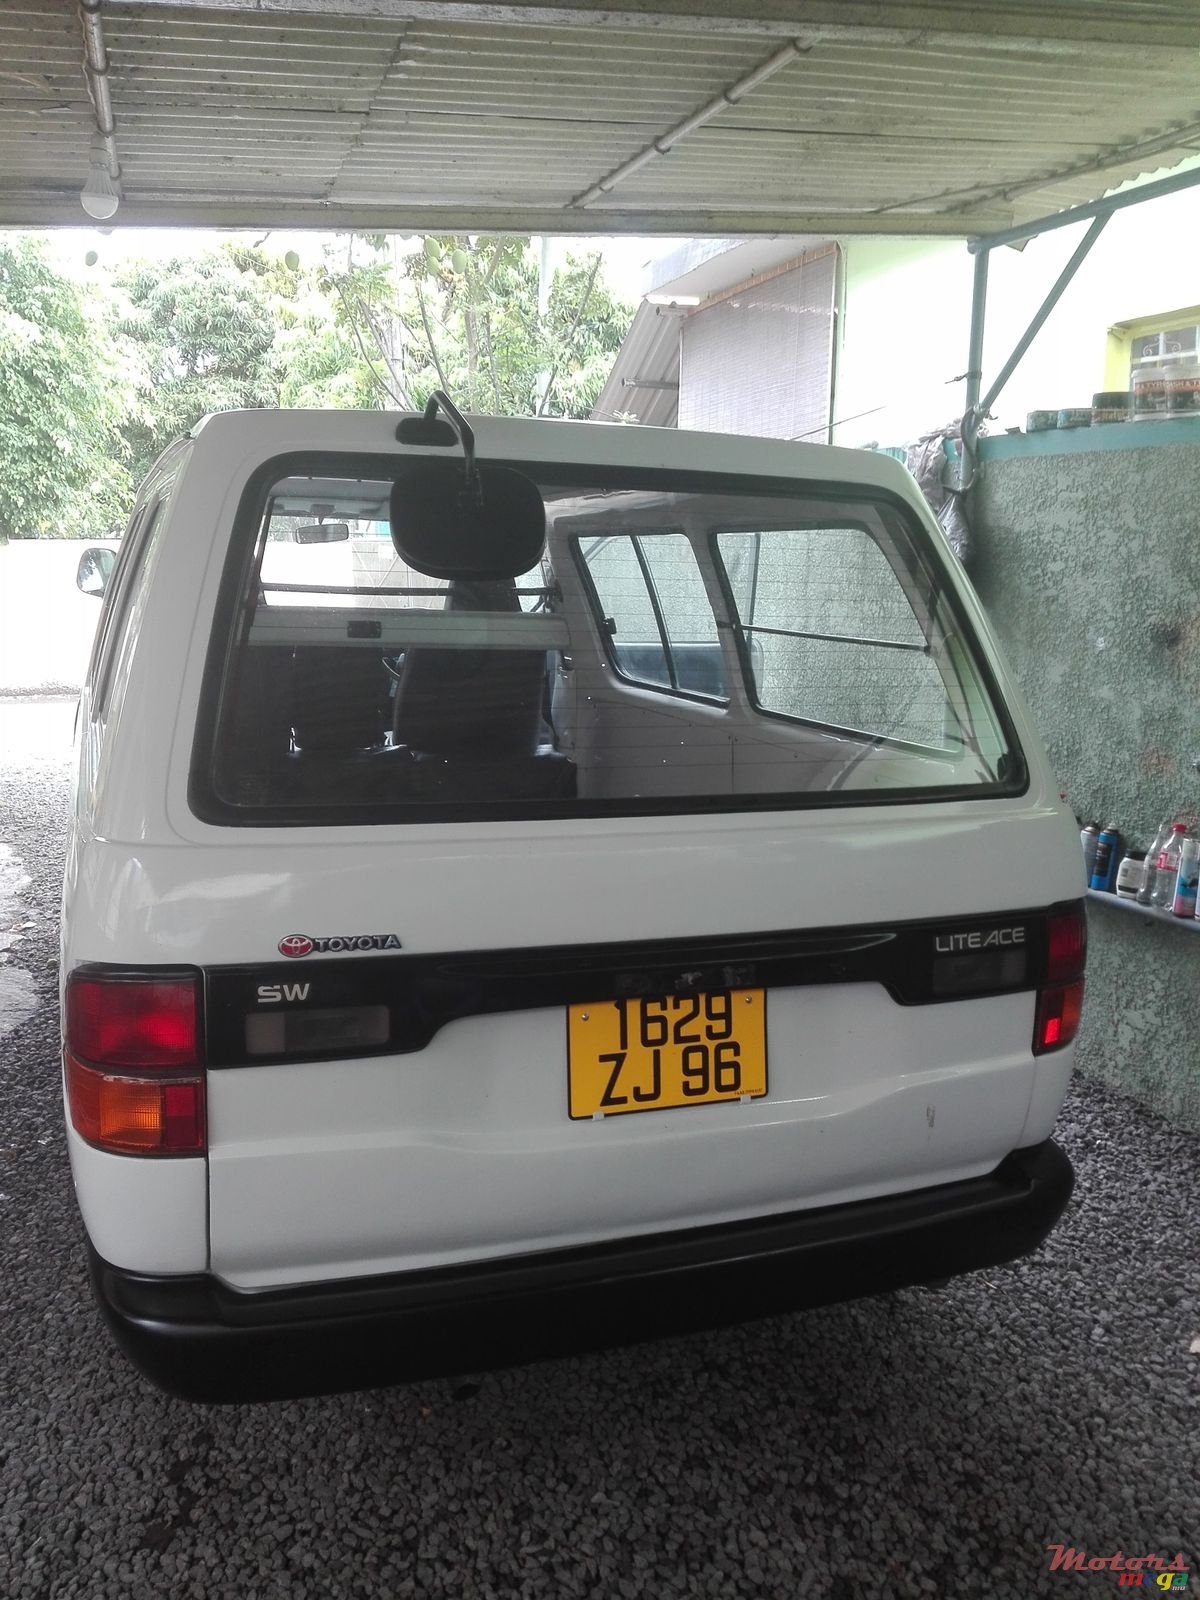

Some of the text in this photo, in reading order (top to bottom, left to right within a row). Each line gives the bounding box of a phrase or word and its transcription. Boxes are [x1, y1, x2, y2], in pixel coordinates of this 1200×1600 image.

[314, 934, 401, 952] TOYOTA
[257, 983, 310, 1003] SW
[614, 991, 732, 1050] 1629
[598, 1041, 741, 1107] ZJ 96
